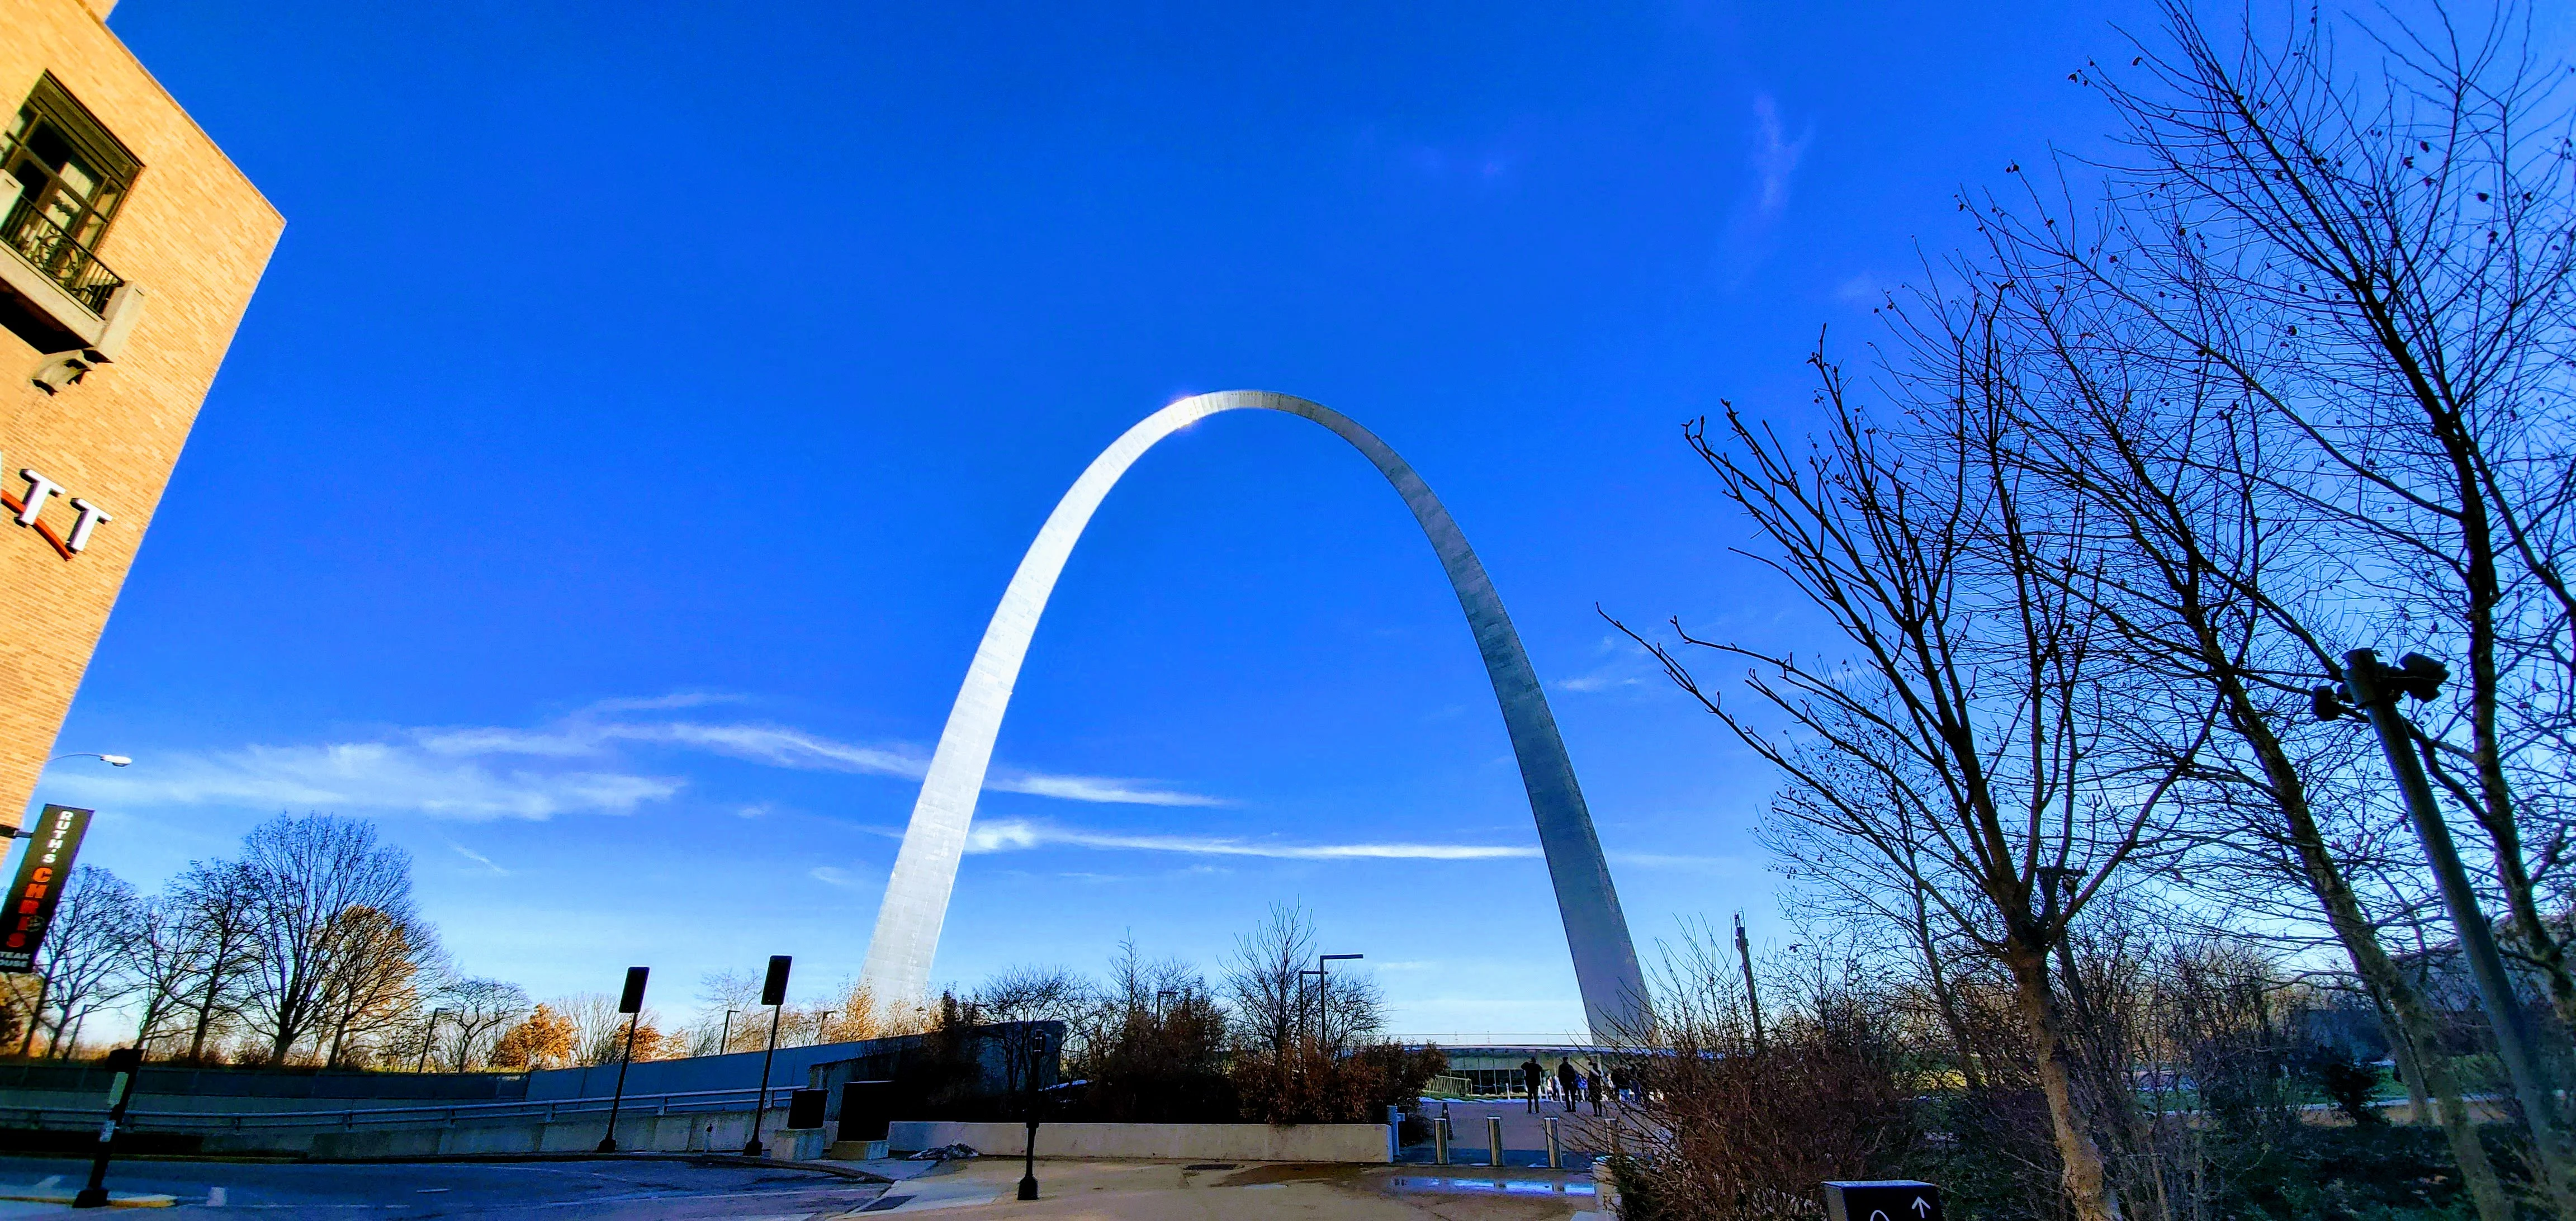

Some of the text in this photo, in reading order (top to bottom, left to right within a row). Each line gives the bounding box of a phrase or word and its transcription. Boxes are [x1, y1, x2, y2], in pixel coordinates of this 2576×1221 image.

[0, 451, 113, 554] TT
[42, 811, 73, 863] RUTH'S
[6, 867, 53, 948] CHRIS
